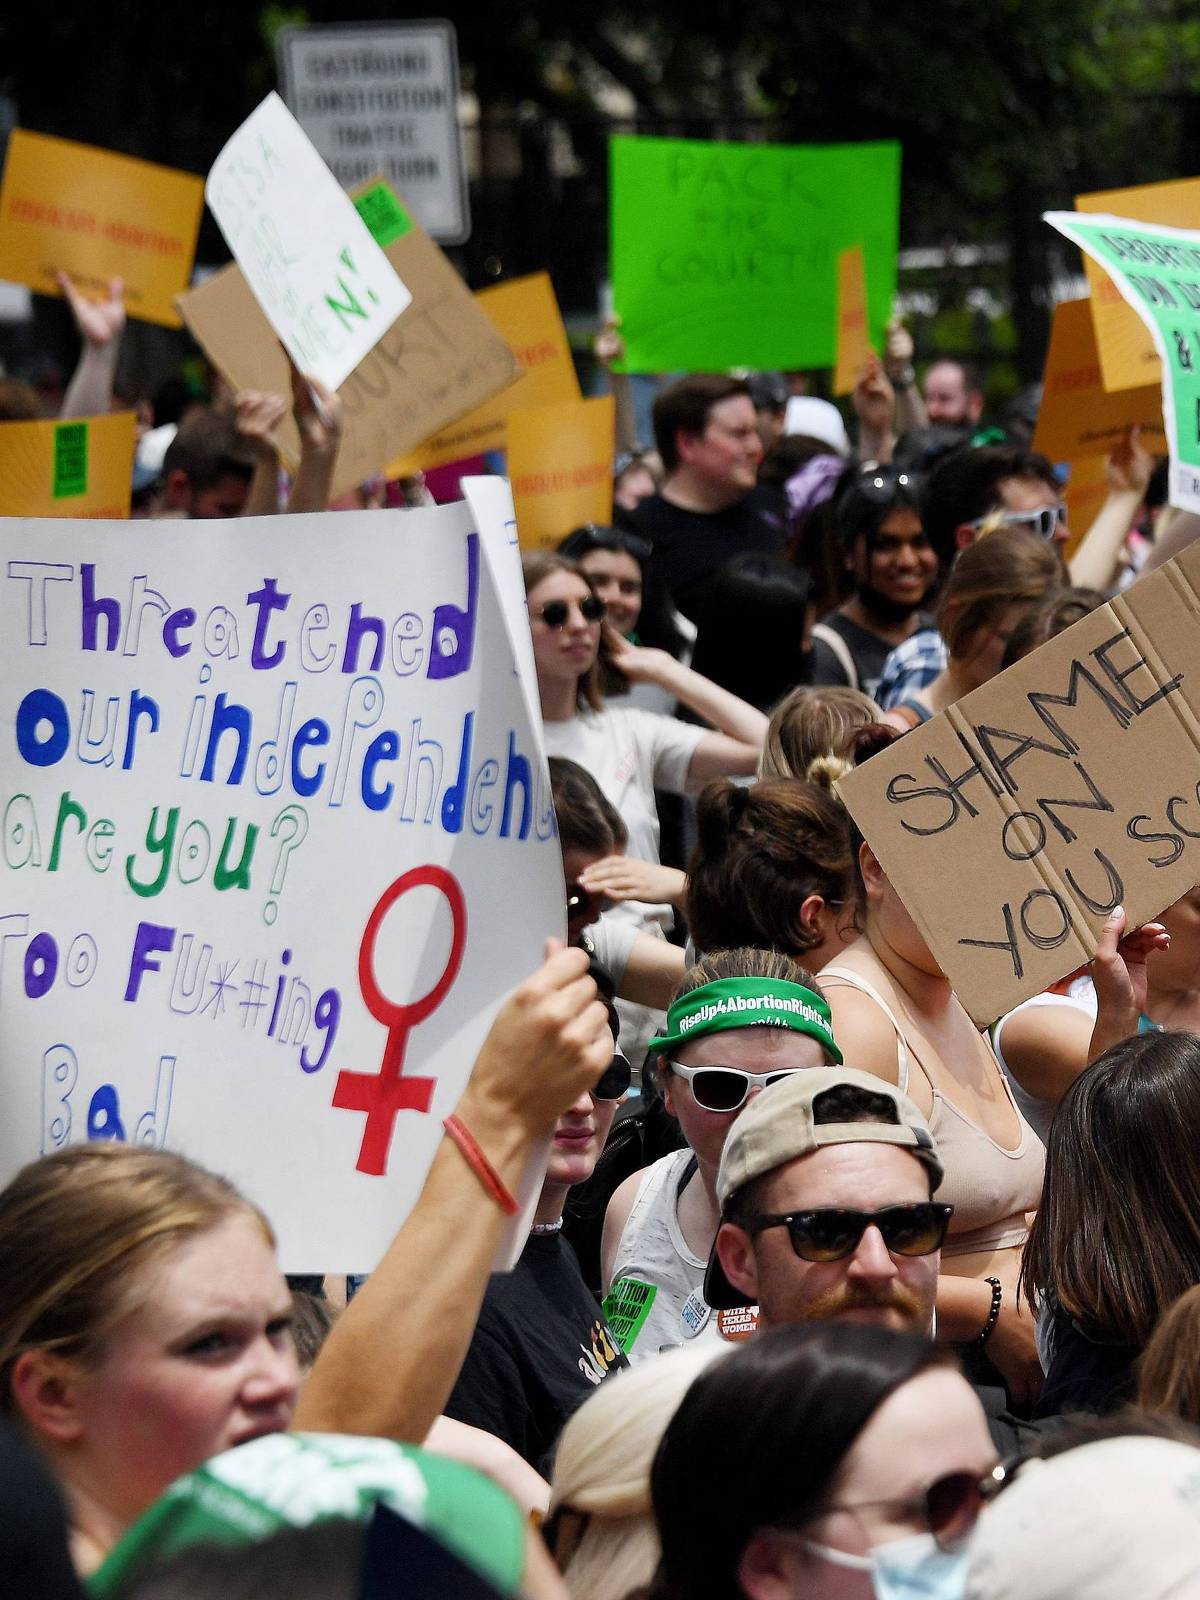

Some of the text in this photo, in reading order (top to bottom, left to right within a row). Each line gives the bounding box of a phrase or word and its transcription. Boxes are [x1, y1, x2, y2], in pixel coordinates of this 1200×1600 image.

[1173, 329, 1193, 371] &
[8, 532, 480, 680] Threatened
[16, 687, 161, 771] our
[885, 627, 1184, 836] SHAME
[3, 791, 310, 926] are you?
[1002, 761, 1114, 861] ON
[958, 848, 1124, 980] YOU
[722, 1314, 752, 1326] TEXAS
[722, 1322, 757, 1335] WOMEN
